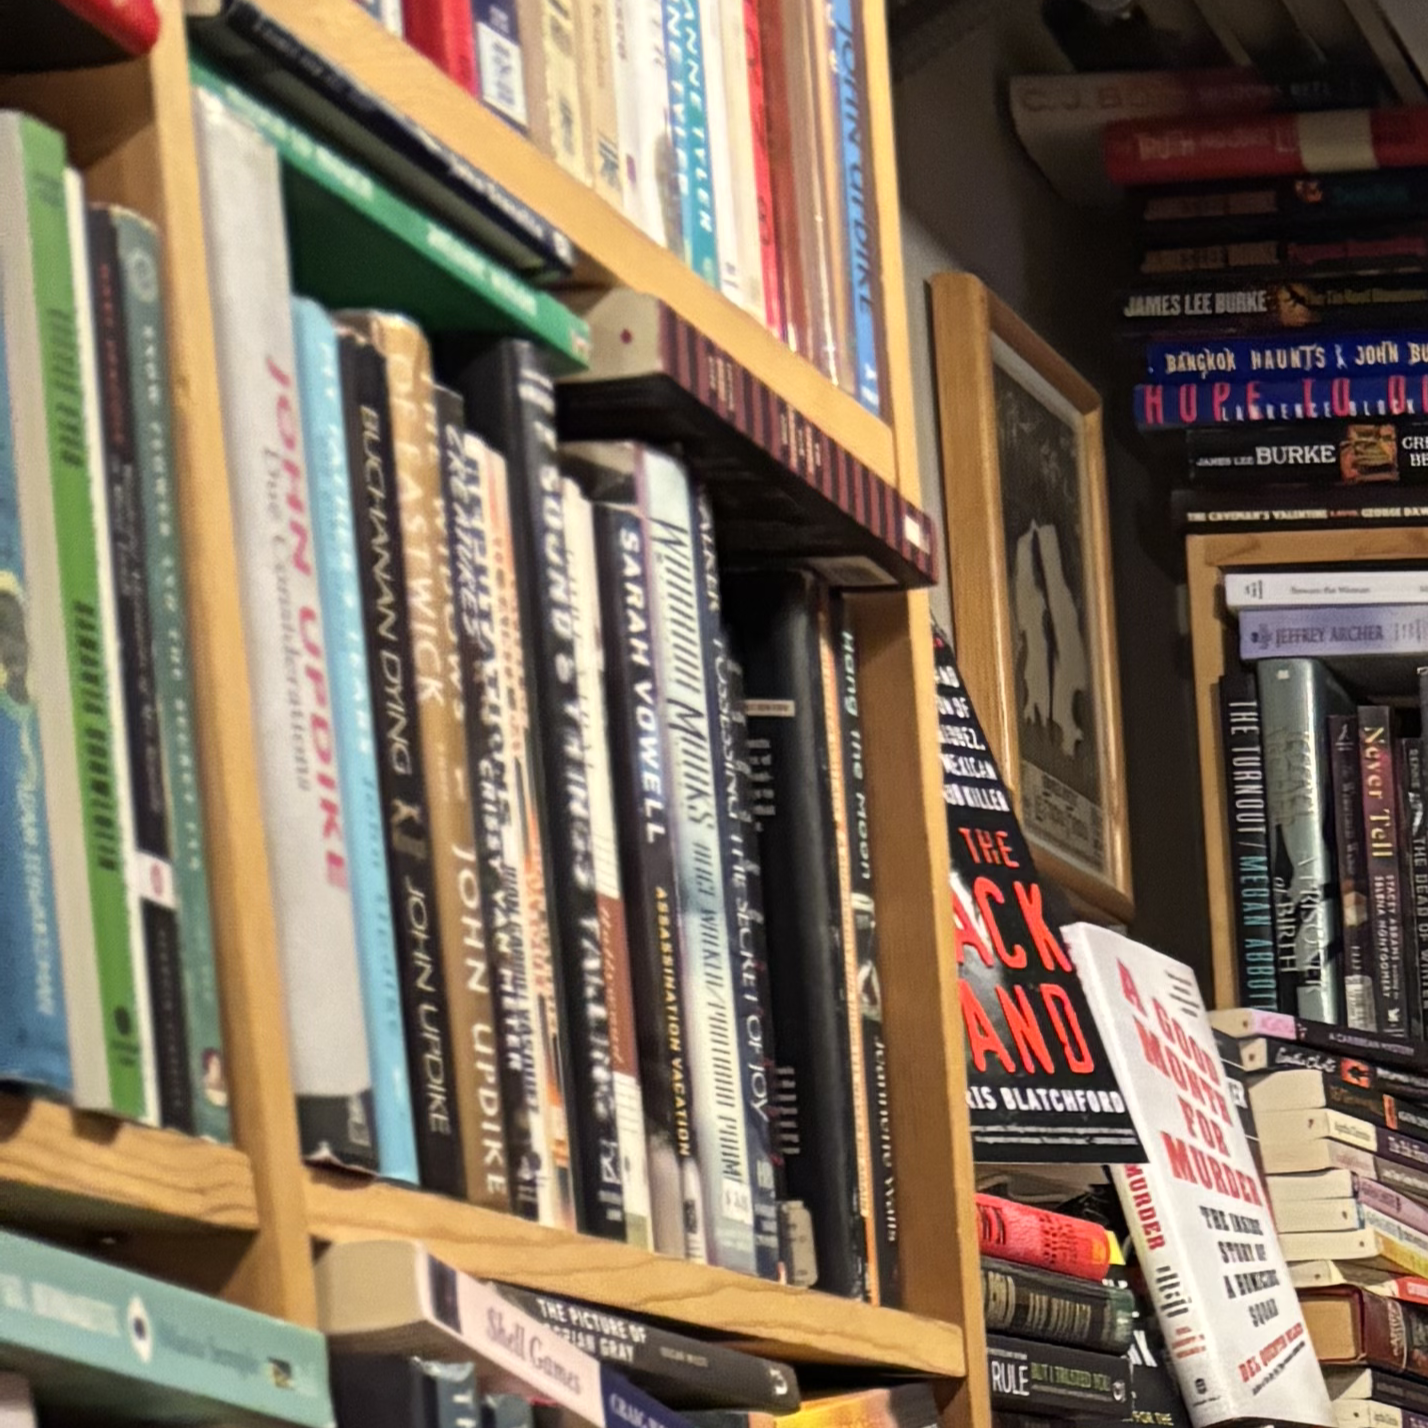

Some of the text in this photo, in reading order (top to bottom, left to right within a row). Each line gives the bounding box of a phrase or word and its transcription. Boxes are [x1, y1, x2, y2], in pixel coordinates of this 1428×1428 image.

[1124, 292, 1267, 317] JAMES LEE BURKE
[1255, 443, 1336, 465] BURKE
[1003, 1086, 1124, 1113] BLATCHFORD
[1160, 1130, 1263, 1206] MURDER
